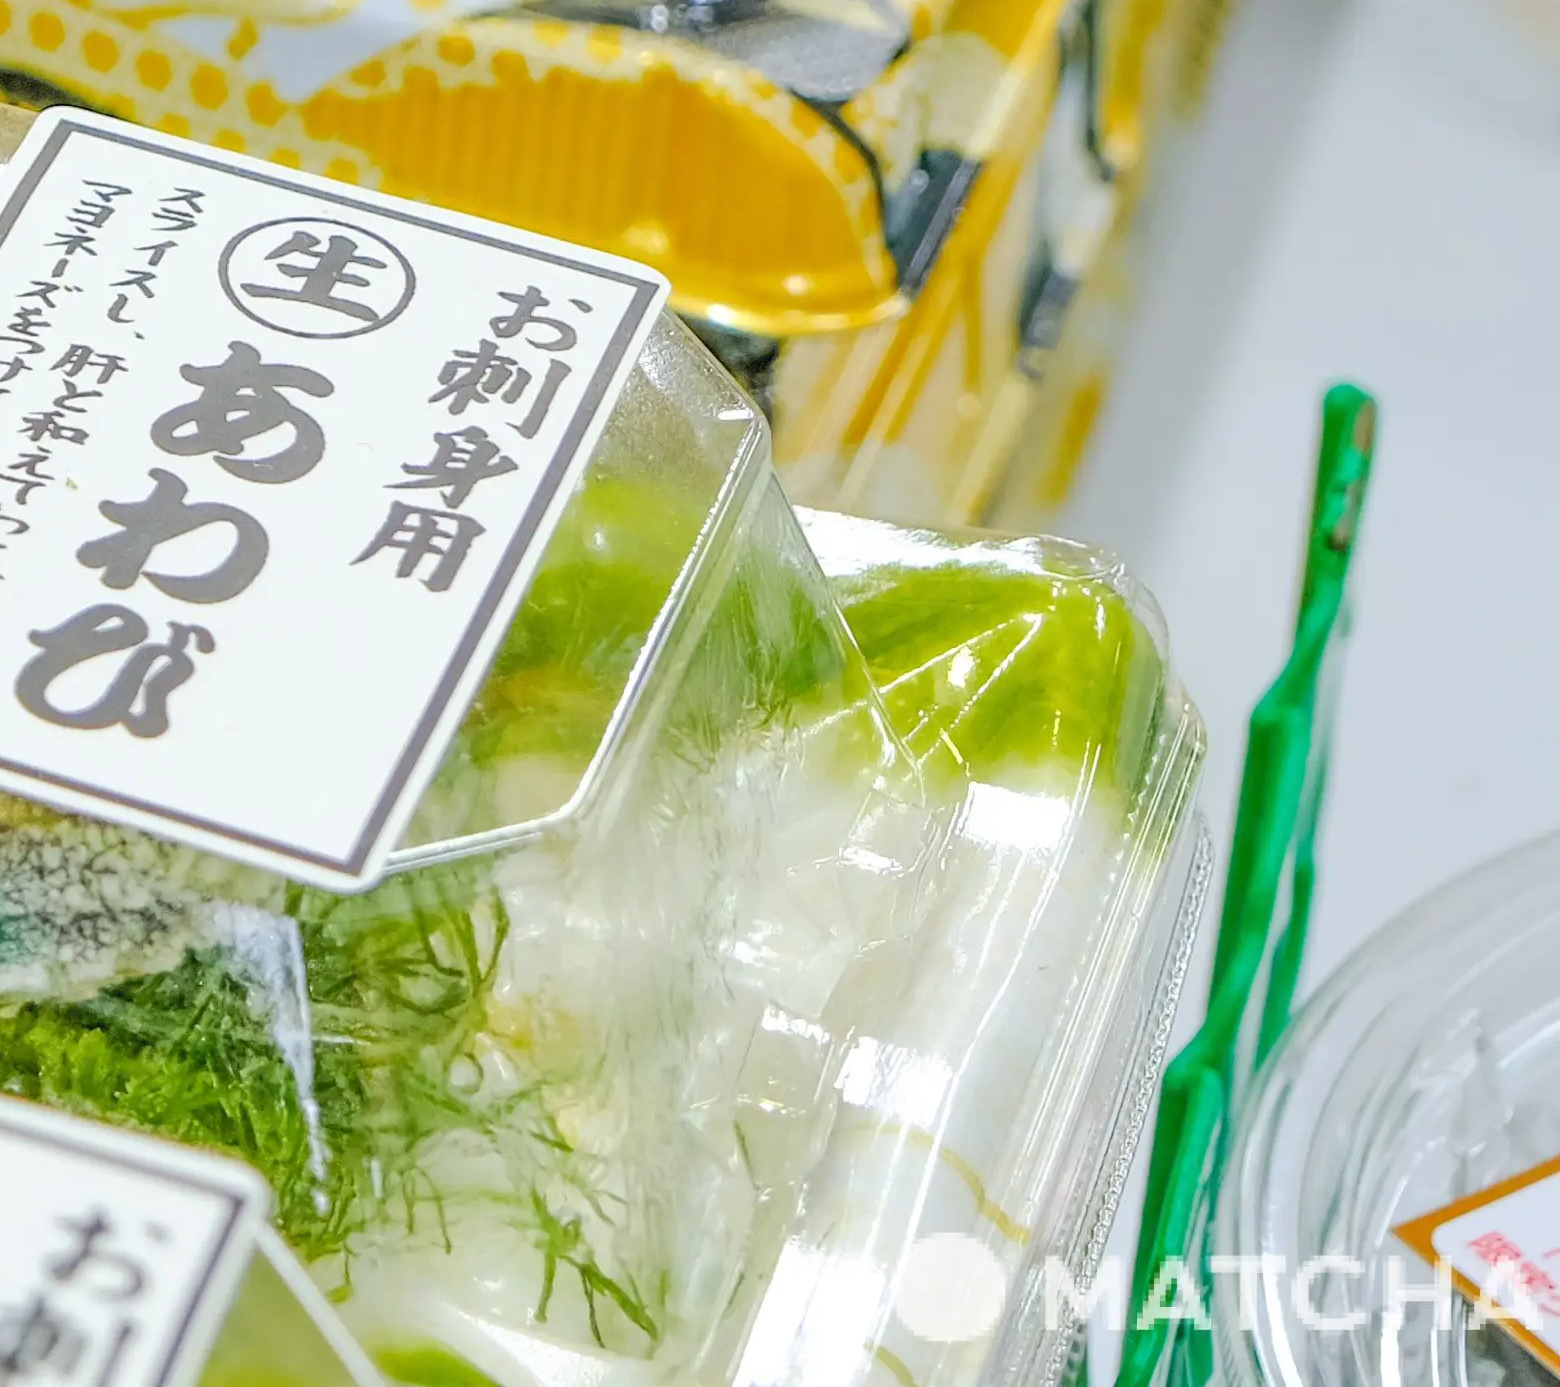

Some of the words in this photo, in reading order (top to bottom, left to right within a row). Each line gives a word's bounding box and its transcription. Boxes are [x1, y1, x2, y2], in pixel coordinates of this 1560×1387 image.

[239, 229, 388, 323] 生
[13, 339, 336, 740] あわび
[349, 284, 594, 594] お刺身用
